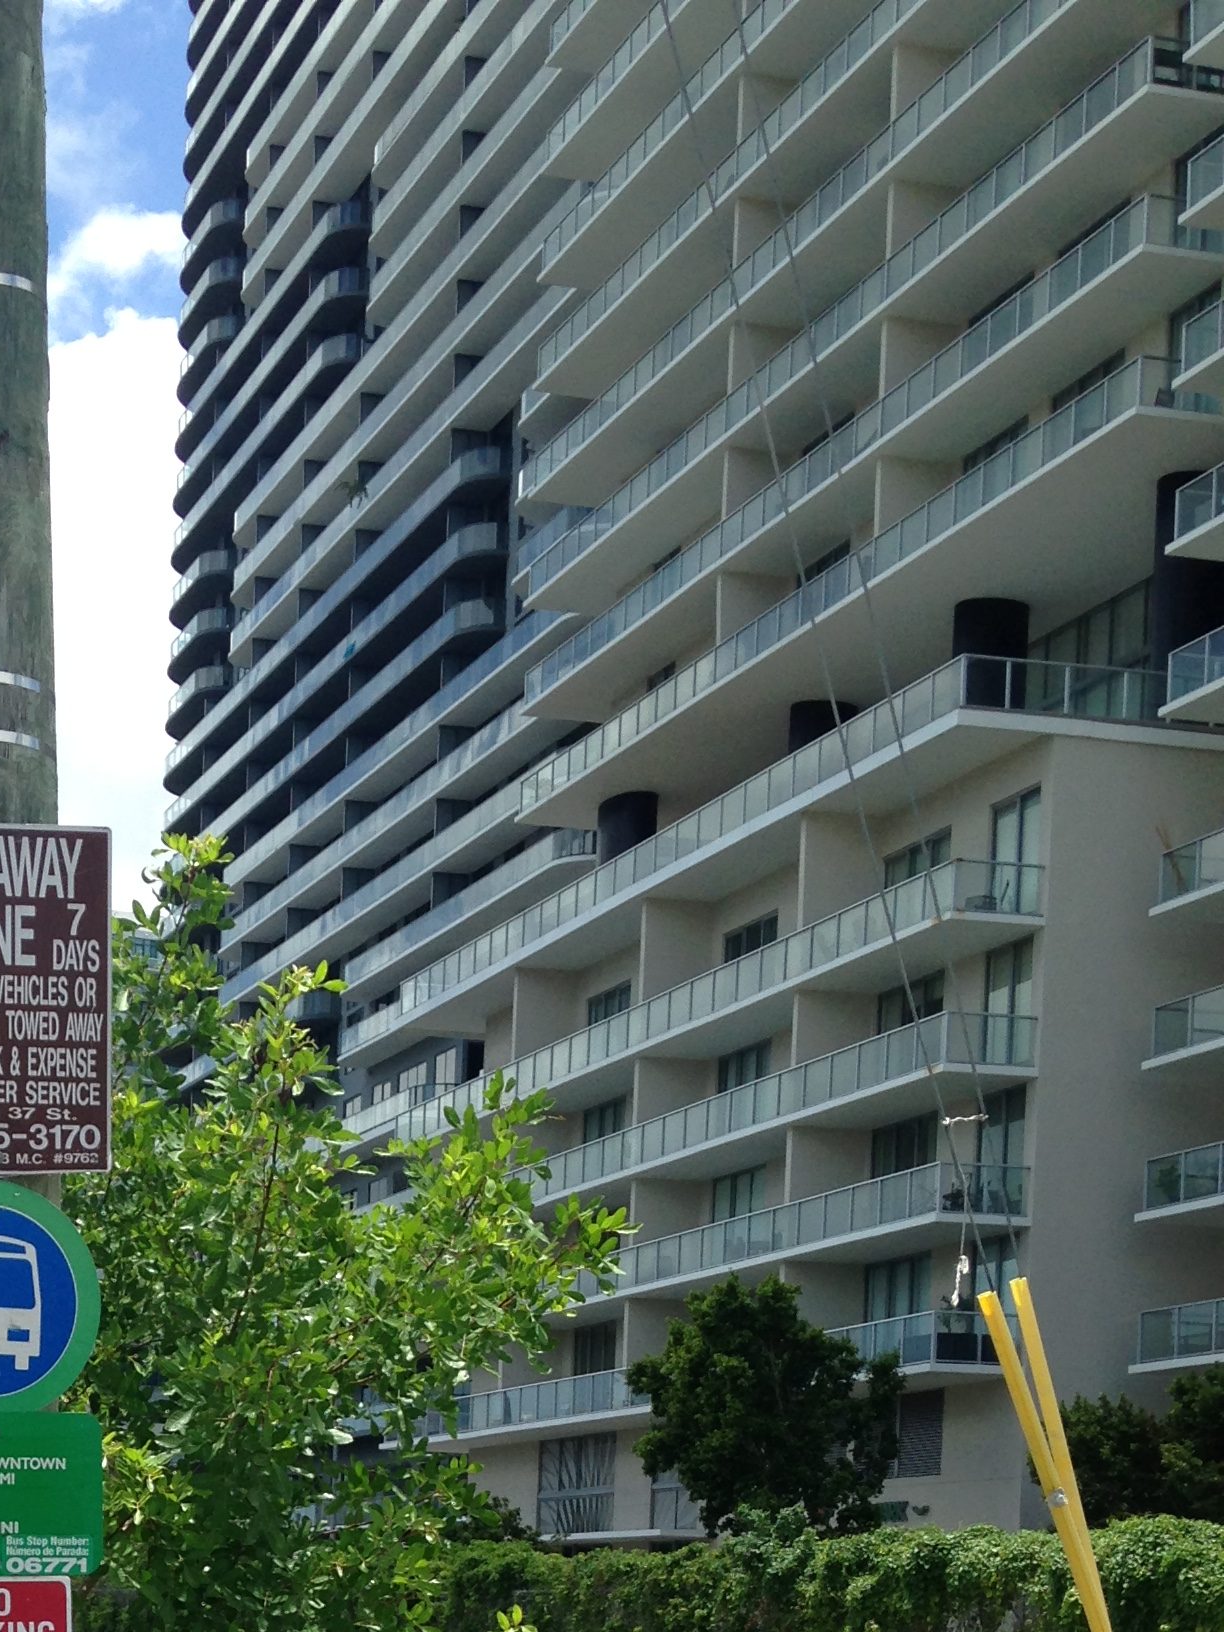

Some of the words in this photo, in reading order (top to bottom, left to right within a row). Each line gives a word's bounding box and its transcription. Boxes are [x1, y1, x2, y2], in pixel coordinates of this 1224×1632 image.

[67, 903, 87, 936] 7
[52, 939, 100, 971] DAYS
[74, 977, 96, 1007] OR
[5, 1011, 59, 1041] TOWED
[65, 1013, 104, 1042] AWAY
[9, 1048, 22, 1076] &
[27, 1047, 97, 1078] EXPENSE
[25, 1081, 101, 1106] SERVICE
[8, 1107, 36, 1119] 37
[46, 1107, 77, 1121] St.
[16, 1153, 46, 1165] M.C.
[53, 1152, 99, 1164] #9762
[5, 1545, 41, 1556] Número
[42, 1546, 54, 1556] de
[55, 1547, 89, 1557] Parada:
[6, 1536, 24, 1546] Bus
[26, 1536, 48, 1547] Stop
[50, 1536, 89, 1546] Number:
[5, 1557, 88, 1573] 06771
